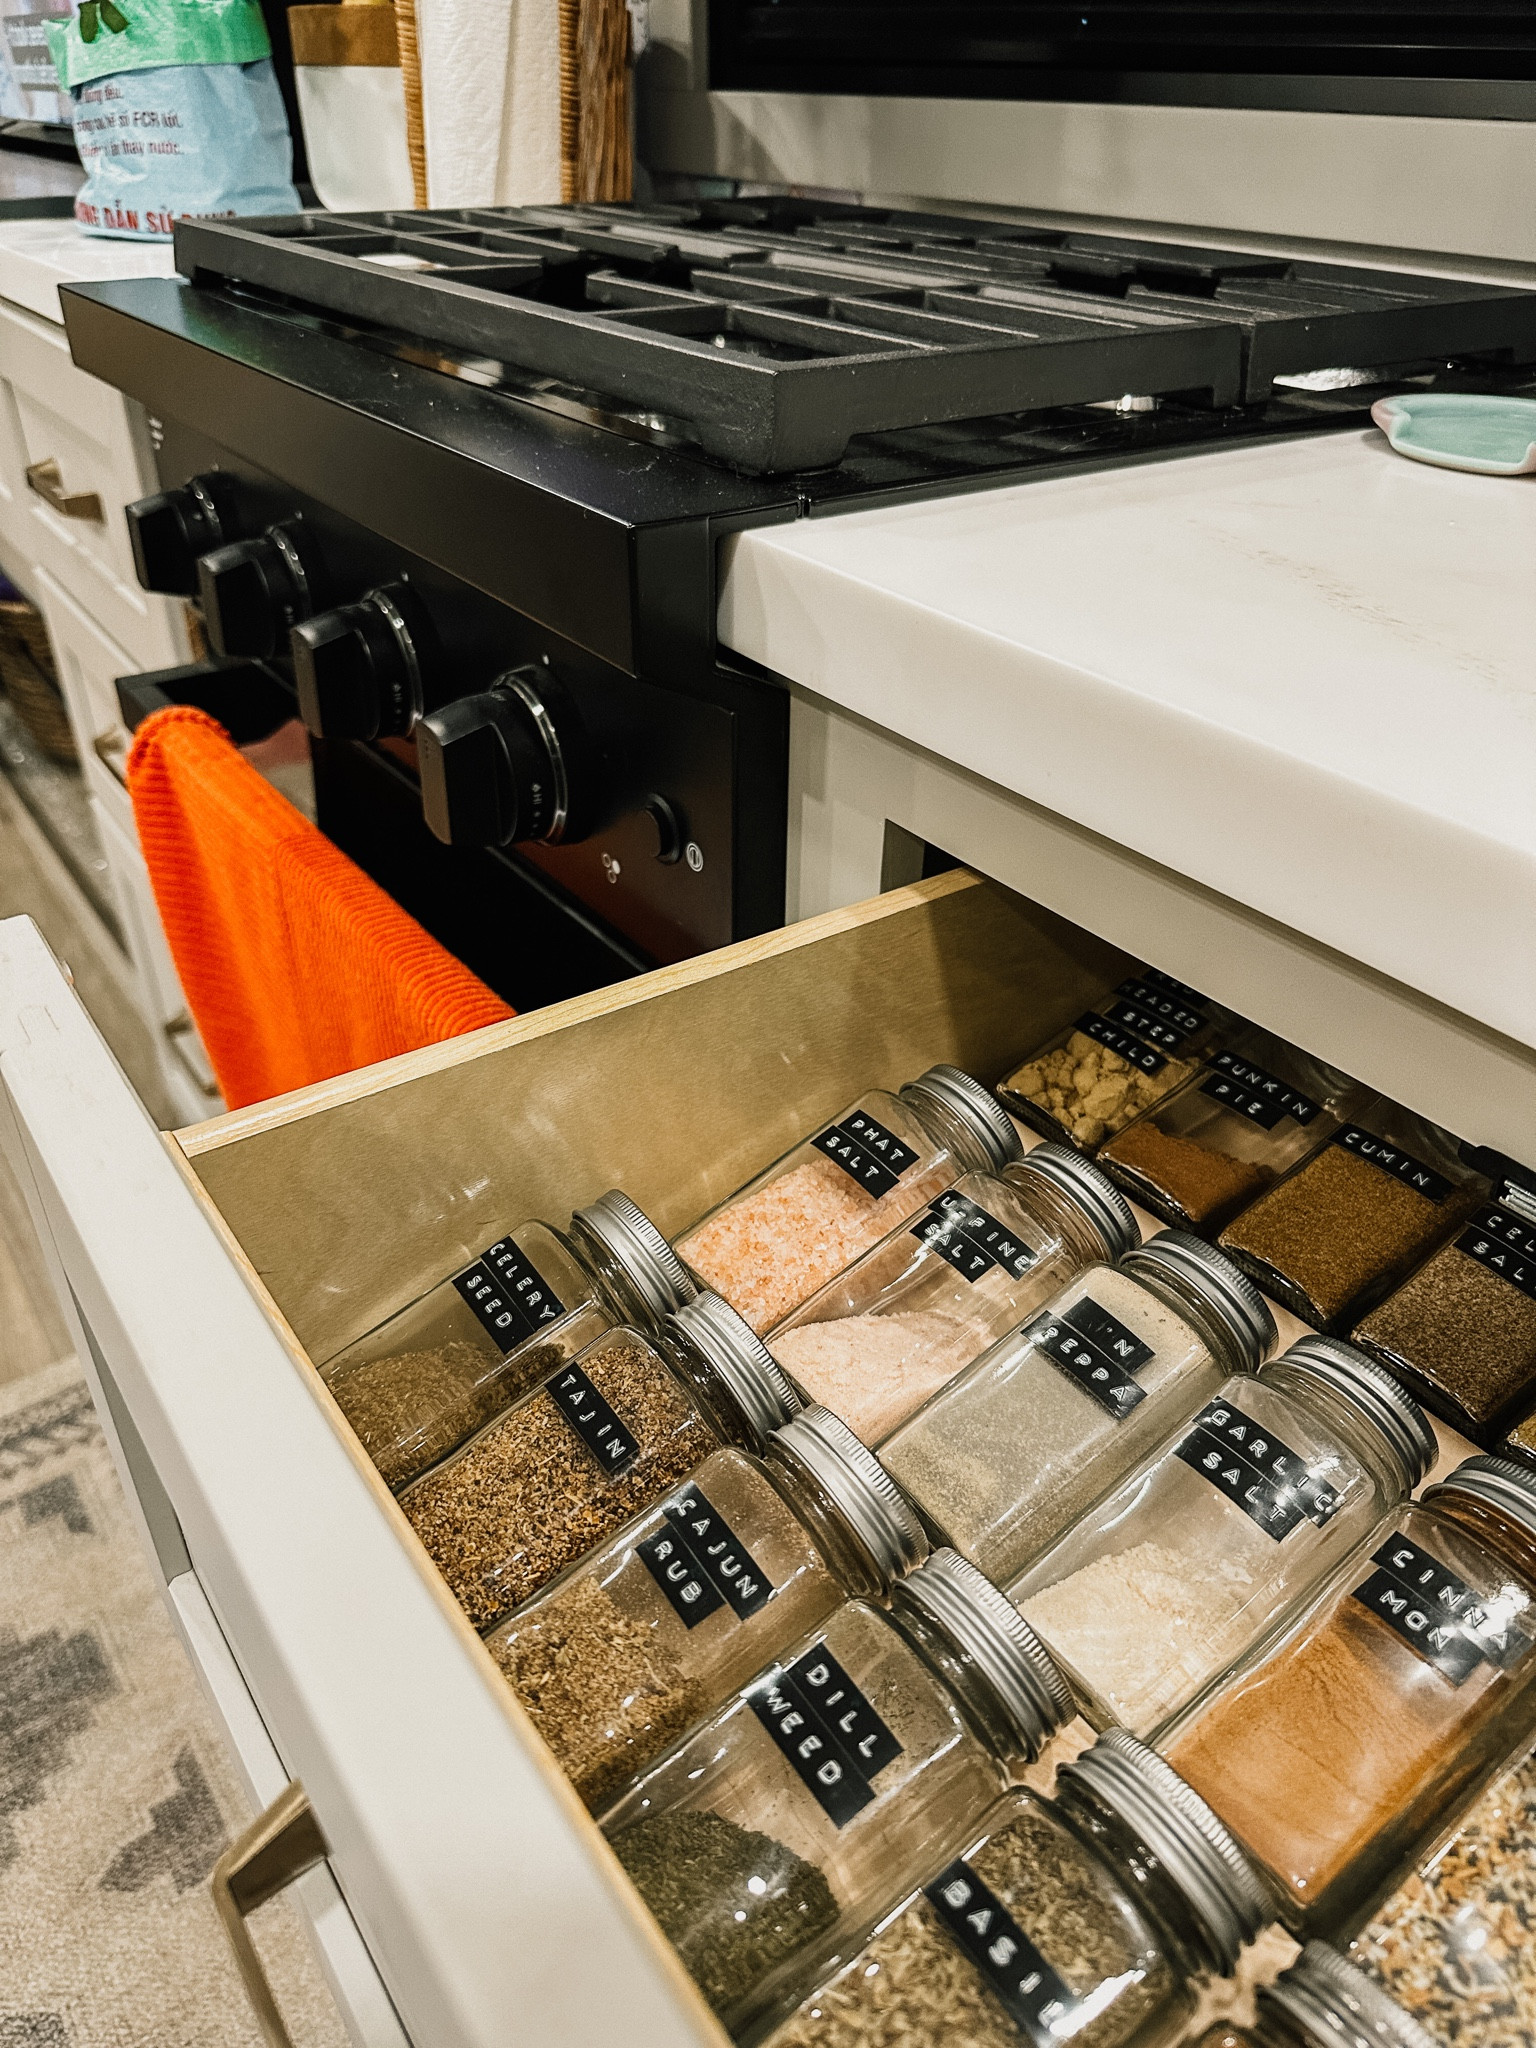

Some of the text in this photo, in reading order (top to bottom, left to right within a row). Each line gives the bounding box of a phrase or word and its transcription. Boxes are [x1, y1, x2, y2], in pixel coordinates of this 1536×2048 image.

[1120, 984, 1198, 1029] HEADED
[1122, 1011, 1176, 1043] STEP
[1089, 1022, 1156, 1067] CHILD
[1215, 1084, 1263, 1115] PIE
[1217, 1055, 1309, 1116] PUNKIN
[825, 1135, 880, 1178] SALT
[850, 1118, 905, 1161] PHAT
[1344, 1132, 1431, 1187] CUMIN
[924, 1222, 986, 1270] SALT
[1486, 1214, 1536, 1252] CEL
[488, 1242, 557, 1320] CELERY
[1472, 1240, 1536, 1292] SAL
[465, 1274, 514, 1329] SEED
[559, 1373, 627, 1459] TAJIN
[1201, 1450, 1287, 1522] SALT
[1211, 1408, 1333, 1513] GARLIC
[654, 1539, 704, 1604] RUB
[676, 1498, 759, 1599] CAJUN
[1378, 1589, 1452, 1651] MON
[1392, 1549, 1508, 1650] CINNA
[765, 1686, 844, 1786] WEED
[804, 1662, 879, 1758] DILL
